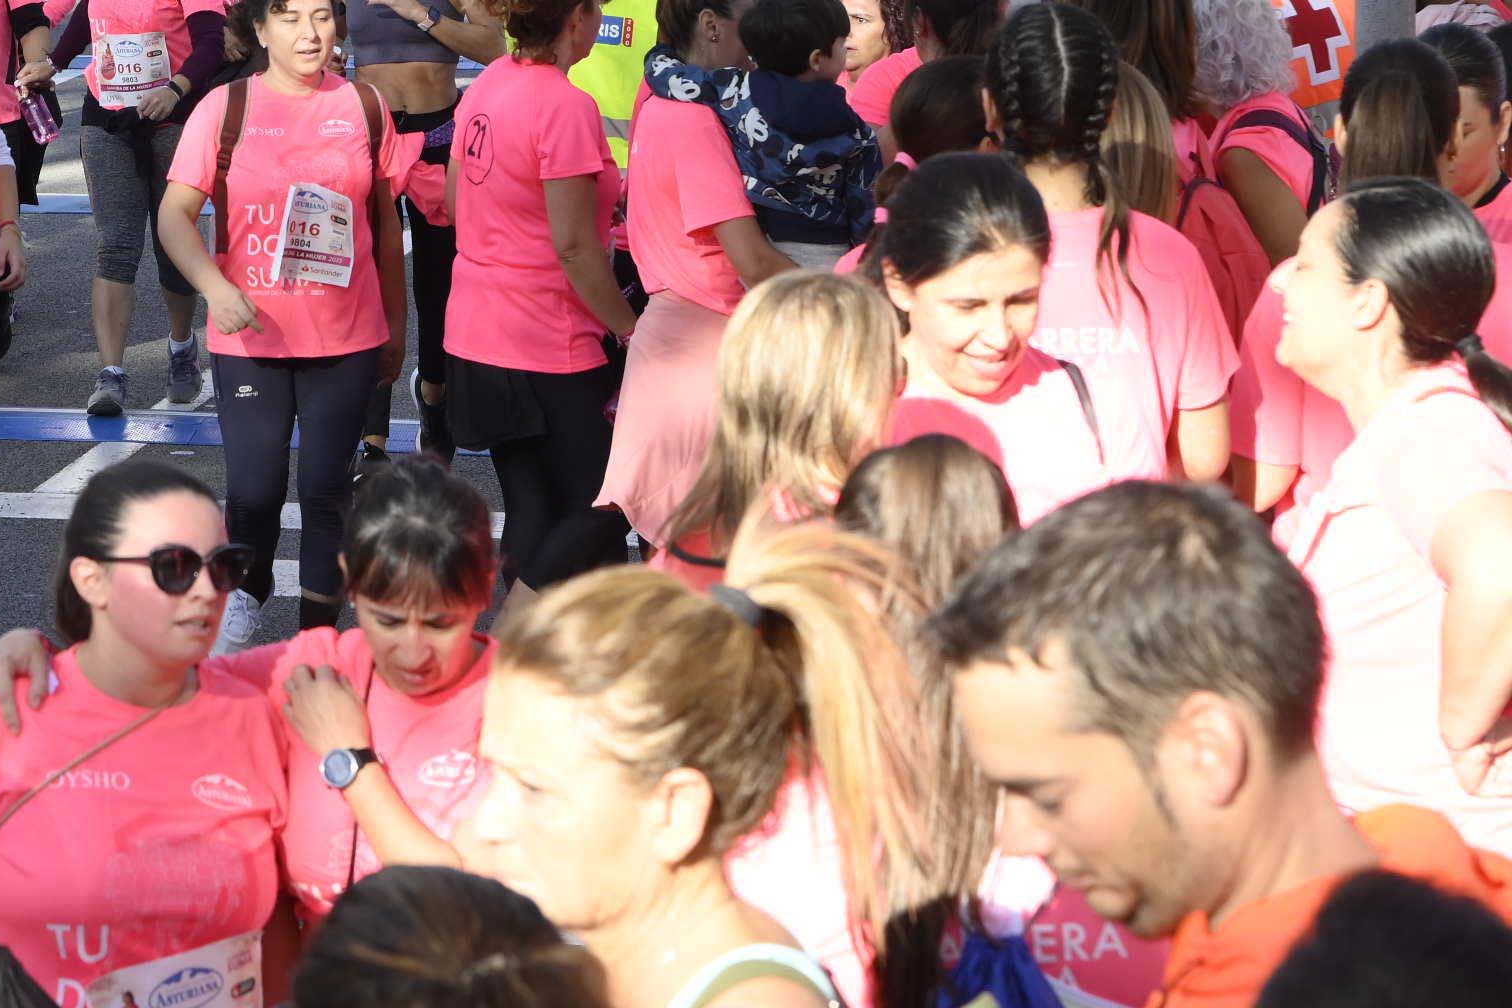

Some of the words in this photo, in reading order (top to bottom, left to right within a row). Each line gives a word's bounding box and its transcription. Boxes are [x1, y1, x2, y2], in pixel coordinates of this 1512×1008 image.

[598, 25, 620, 38] RIS
[117, 63, 142, 74] 016
[467, 119, 487, 160] 21
[245, 203, 275, 225] TU
[294, 200, 326, 211] TURIANA
[289, 220, 321, 236] 016
[247, 234, 281, 256] DO
[305, 253, 327, 261] MUJER
[310, 266, 343, 277] Santander
[48, 768, 130, 792] OYSHO
[195, 784, 253, 808] ASTURIANA
[46, 924, 110, 964] TU
[156, 982, 219, 1008] ASTURIANA
